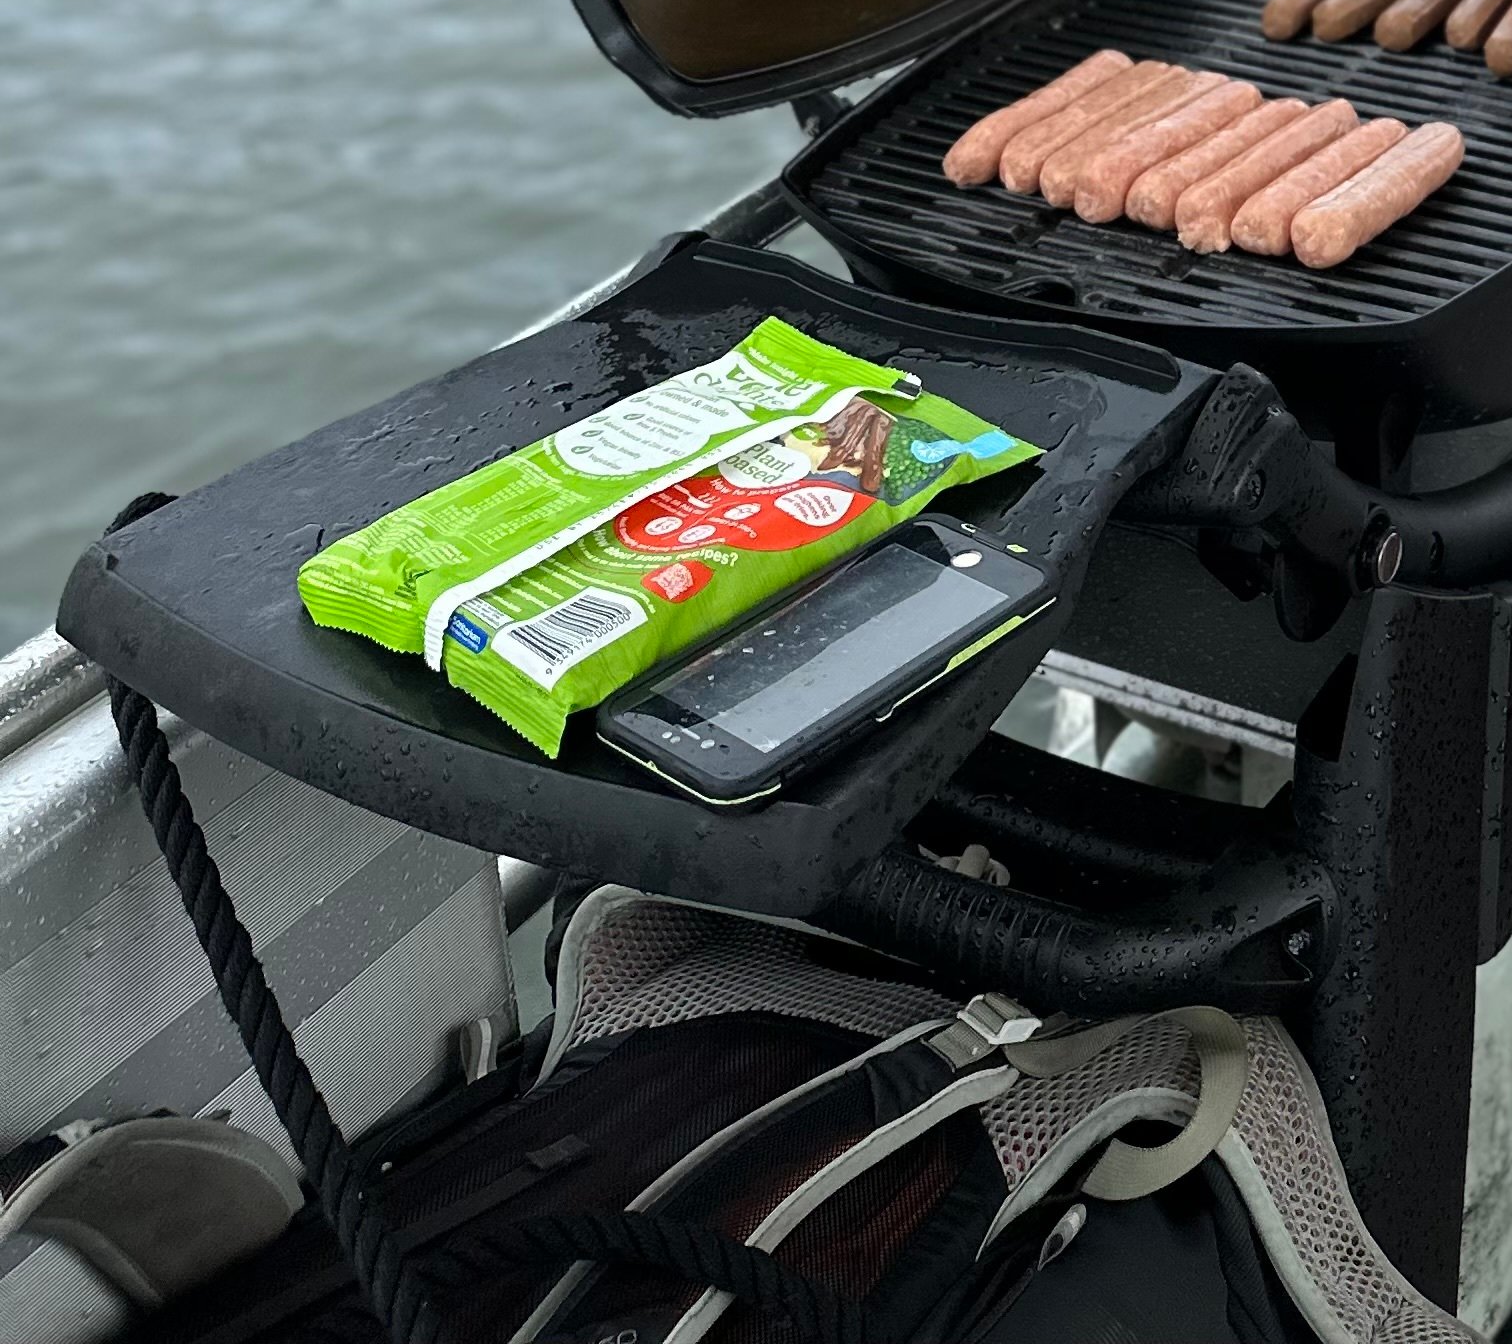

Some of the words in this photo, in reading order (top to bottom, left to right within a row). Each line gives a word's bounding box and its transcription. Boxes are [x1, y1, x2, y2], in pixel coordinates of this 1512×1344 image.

[744, 443, 795, 473] Plant
[710, 478, 733, 494] How
[603, 546, 637, 562] about
[634, 554, 673, 563] some
[675, 548, 739, 568] recipes?
[593, 612, 632, 639] 000500
